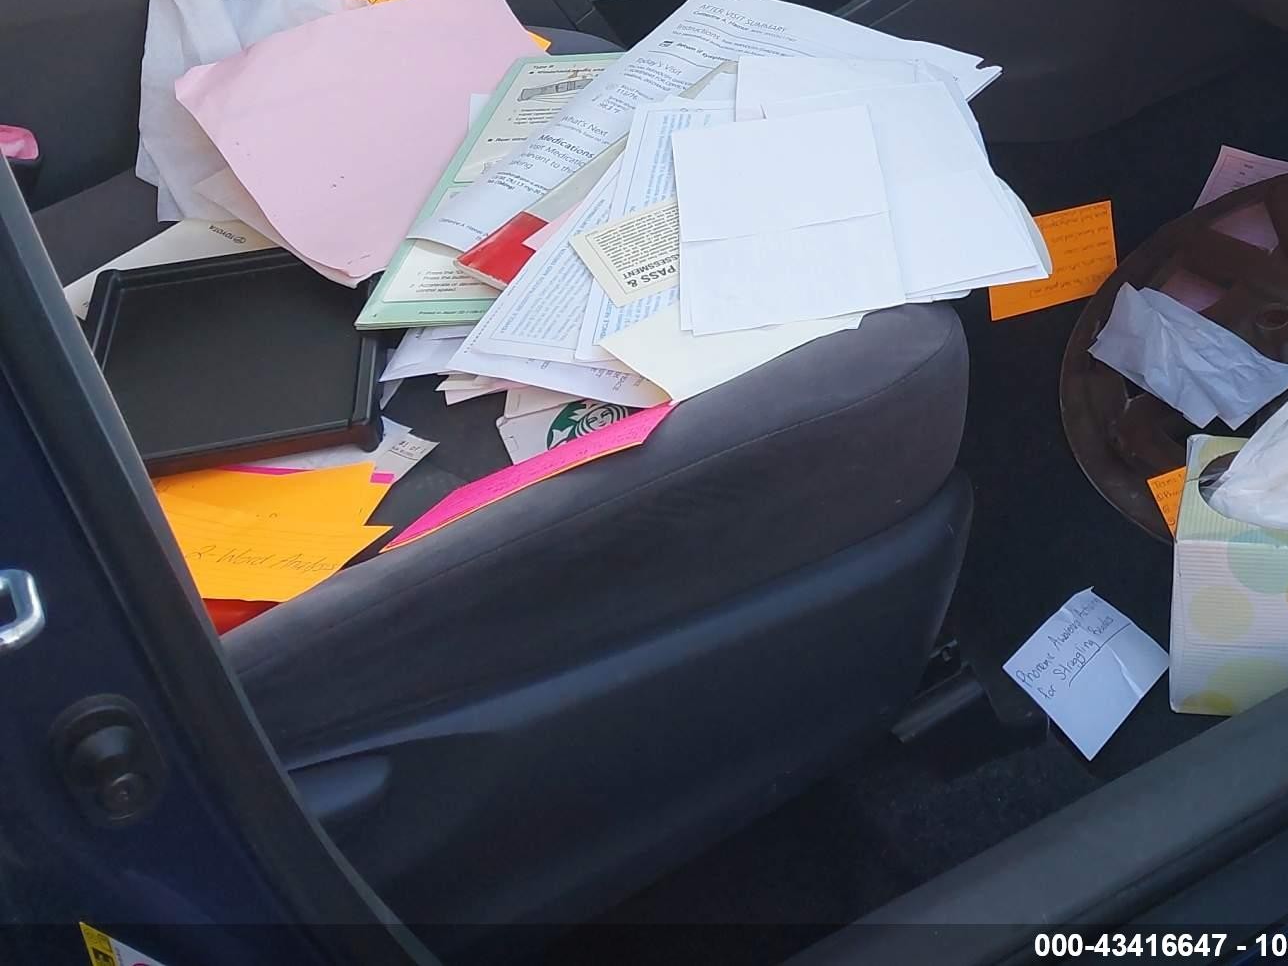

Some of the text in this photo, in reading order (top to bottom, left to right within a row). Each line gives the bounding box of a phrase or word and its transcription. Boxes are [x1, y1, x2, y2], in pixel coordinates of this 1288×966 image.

[700, 3, 725, 16] AFTER
[725, 10, 745, 21] VISIT
[745, 17, 786, 33] SUMMARY
[588, 123, 609, 138] Next
[538, 133, 596, 160] Medications
[550, 160, 561, 170] to
[626, 264, 677, 289] PASS &
[1036, 683, 1057, 700] for
[1052, 638, 1101, 682] Struggling
